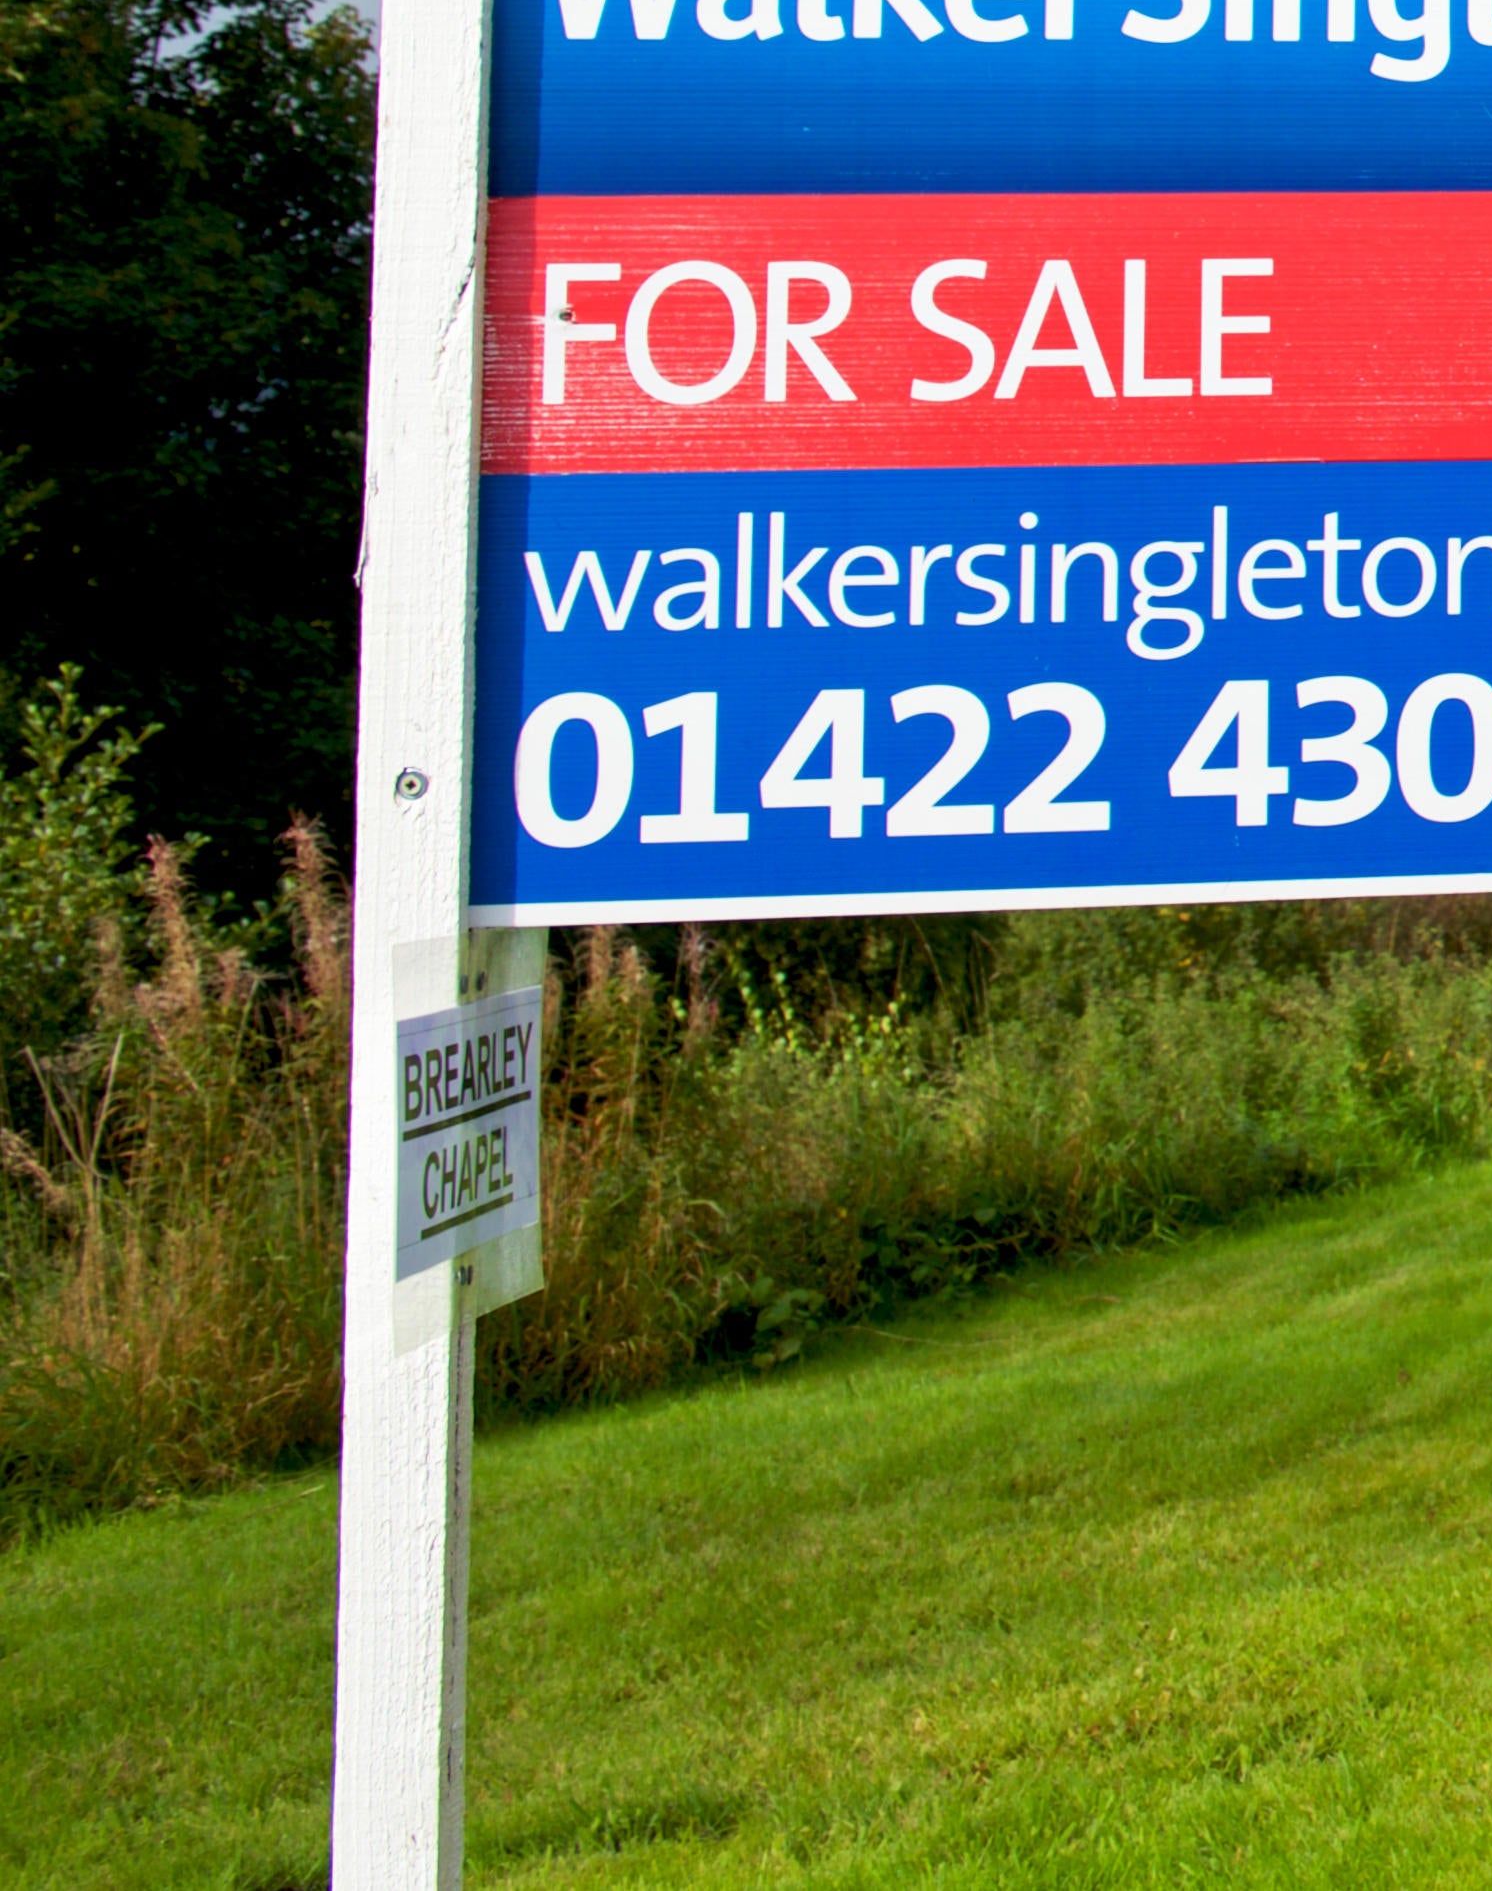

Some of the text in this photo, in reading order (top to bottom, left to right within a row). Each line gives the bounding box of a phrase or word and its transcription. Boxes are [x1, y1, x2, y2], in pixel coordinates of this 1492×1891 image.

[544, 258, 1274, 406] FOR SALE
[514, 681, 1110, 849] 01422
[403, 1022, 533, 1123] BREARLEY
[422, 1126, 514, 1219] CHAPEL
